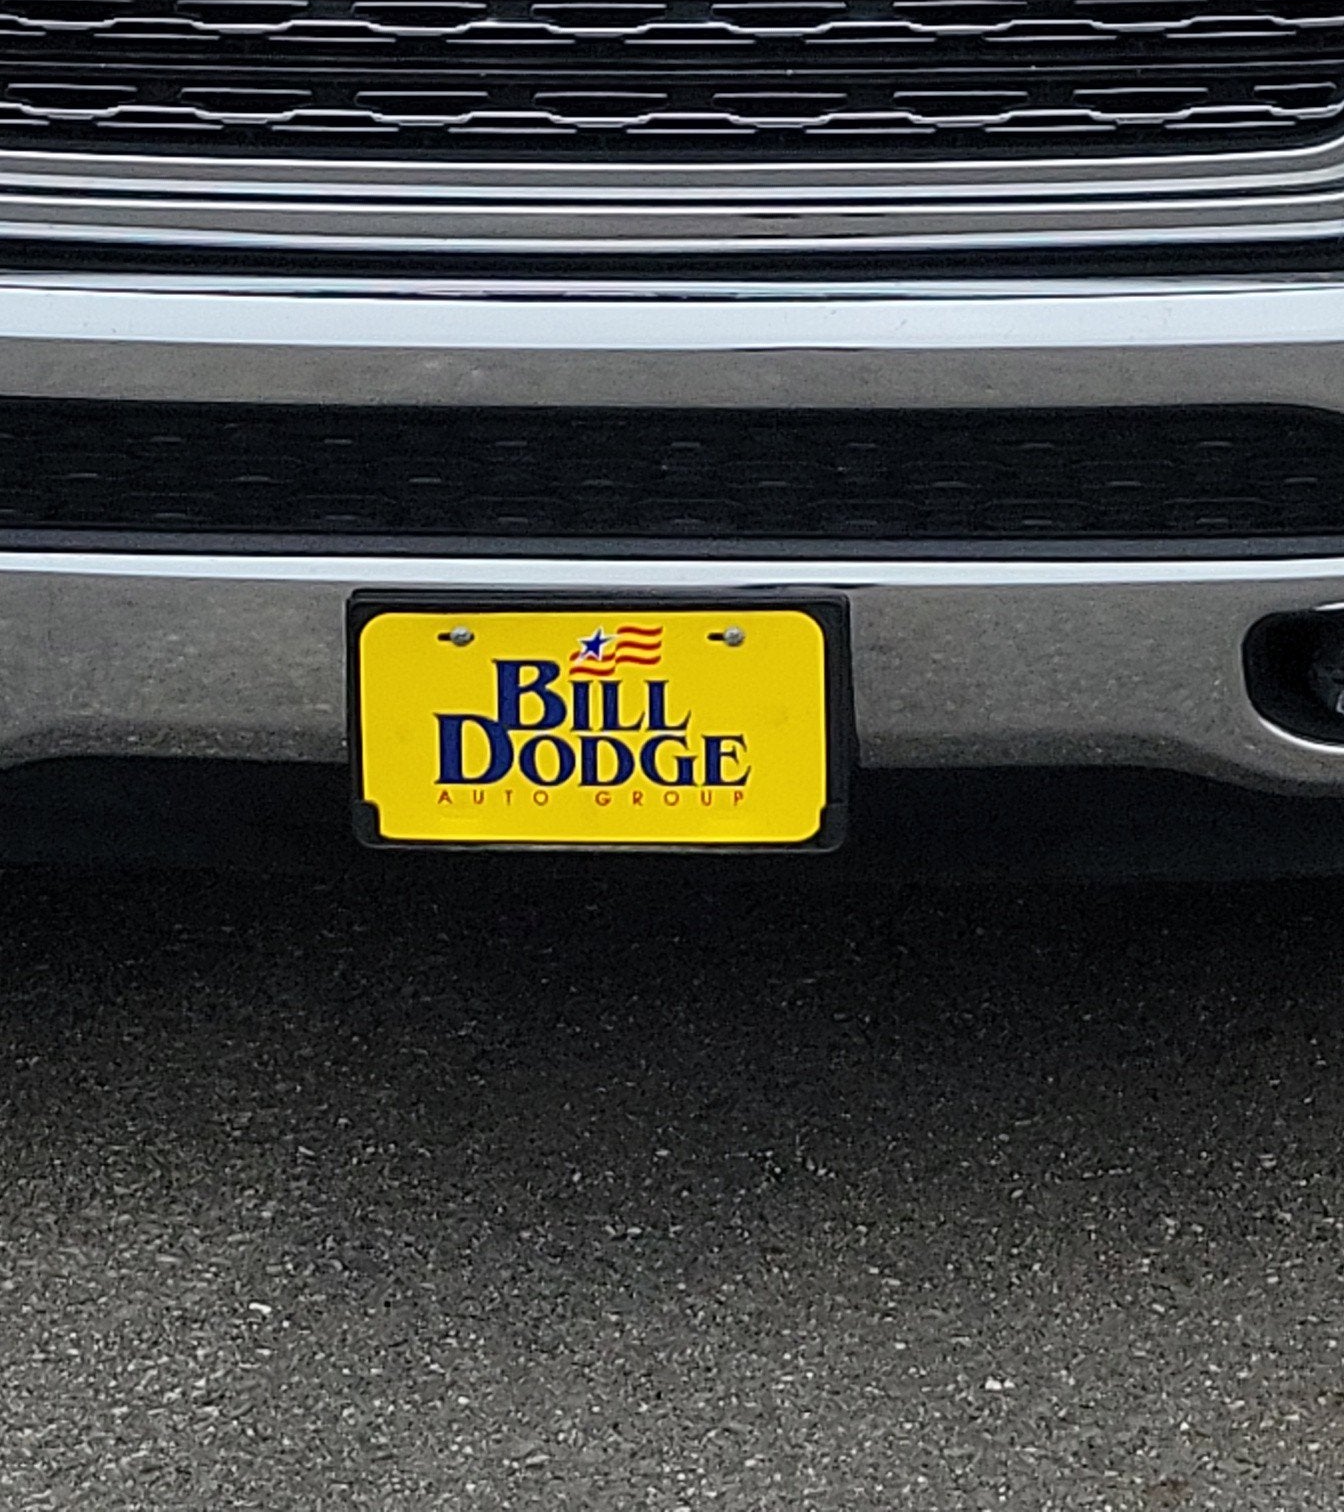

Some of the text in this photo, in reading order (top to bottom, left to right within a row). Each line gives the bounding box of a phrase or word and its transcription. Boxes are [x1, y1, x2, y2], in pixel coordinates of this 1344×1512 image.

[492, 658, 692, 732] BILL
[432, 711, 752, 787] DODGE
[436, 789, 747, 808] AUTO GROUP
